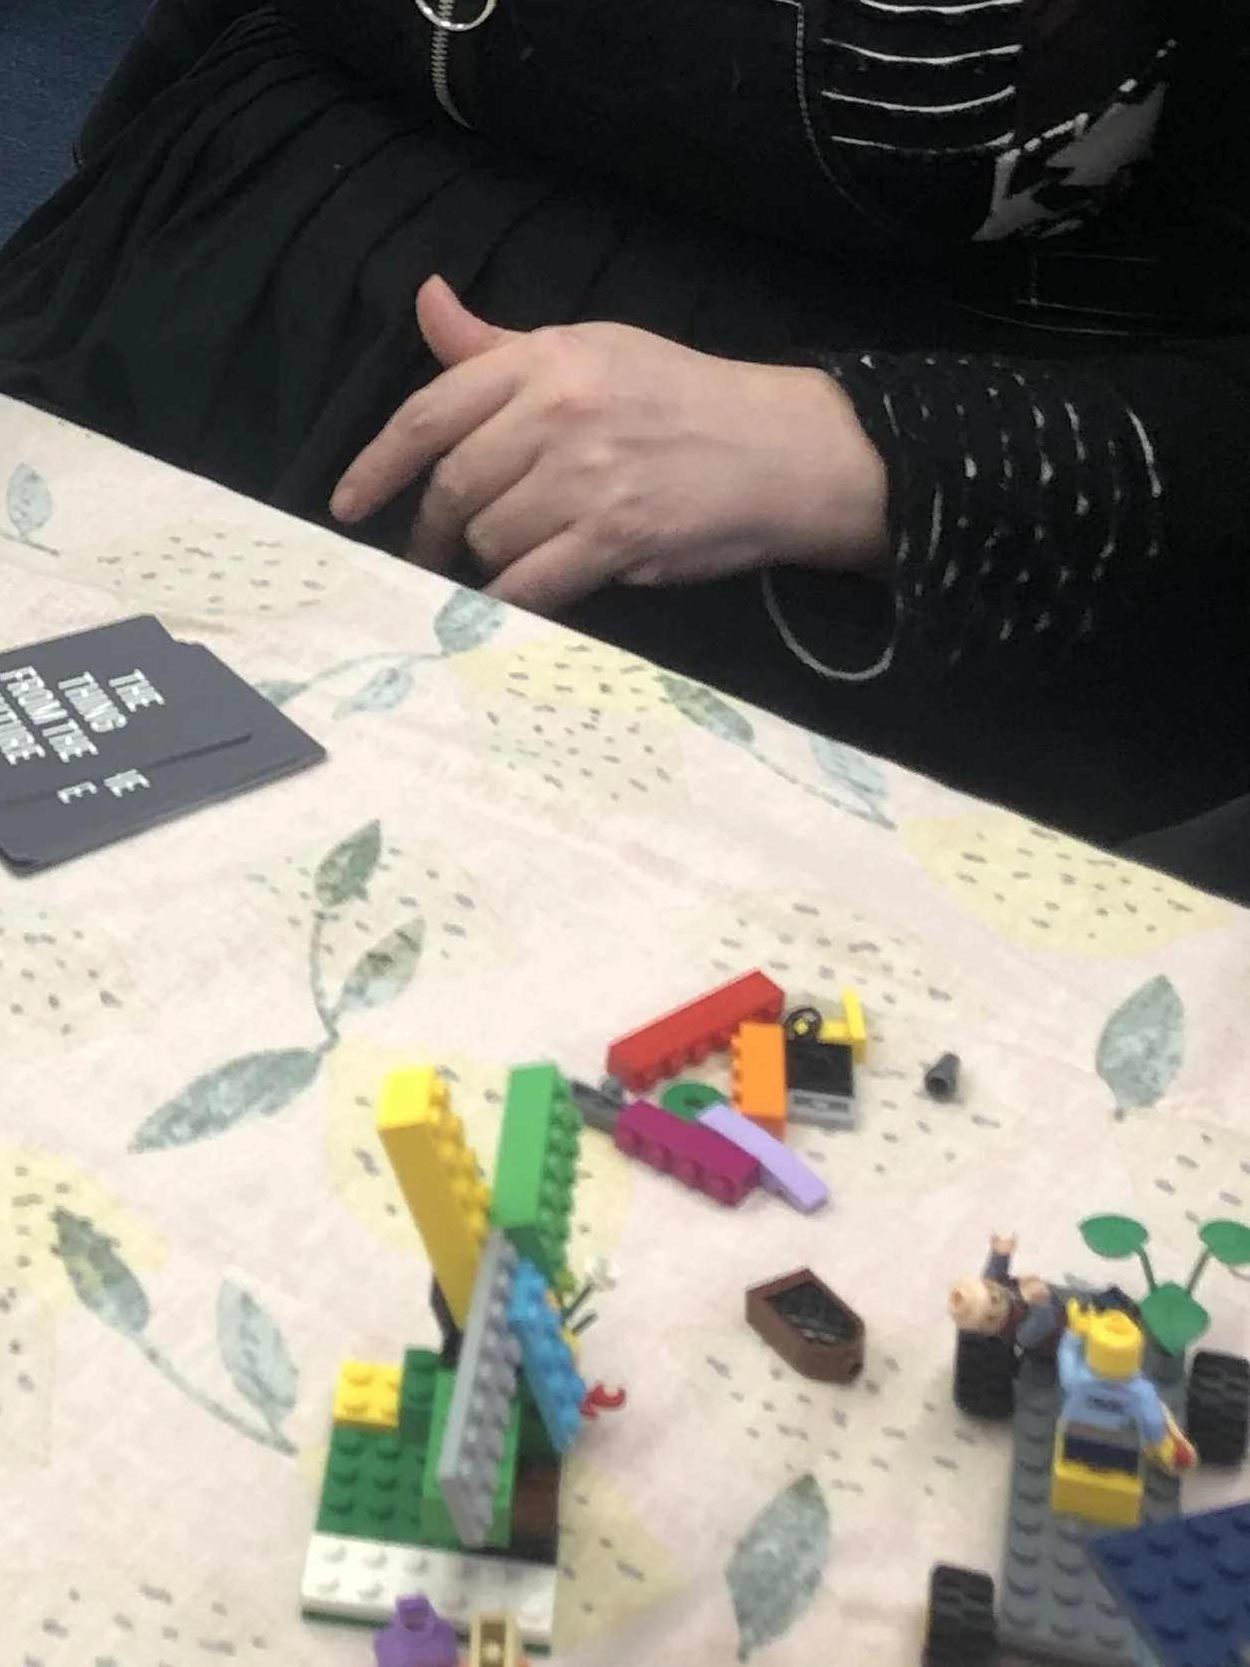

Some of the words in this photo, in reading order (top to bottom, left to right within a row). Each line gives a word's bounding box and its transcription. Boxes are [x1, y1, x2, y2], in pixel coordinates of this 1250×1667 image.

[57, 671, 128, 733] THING
[108, 668, 165, 713] THE
[41, 718, 99, 763] THE
